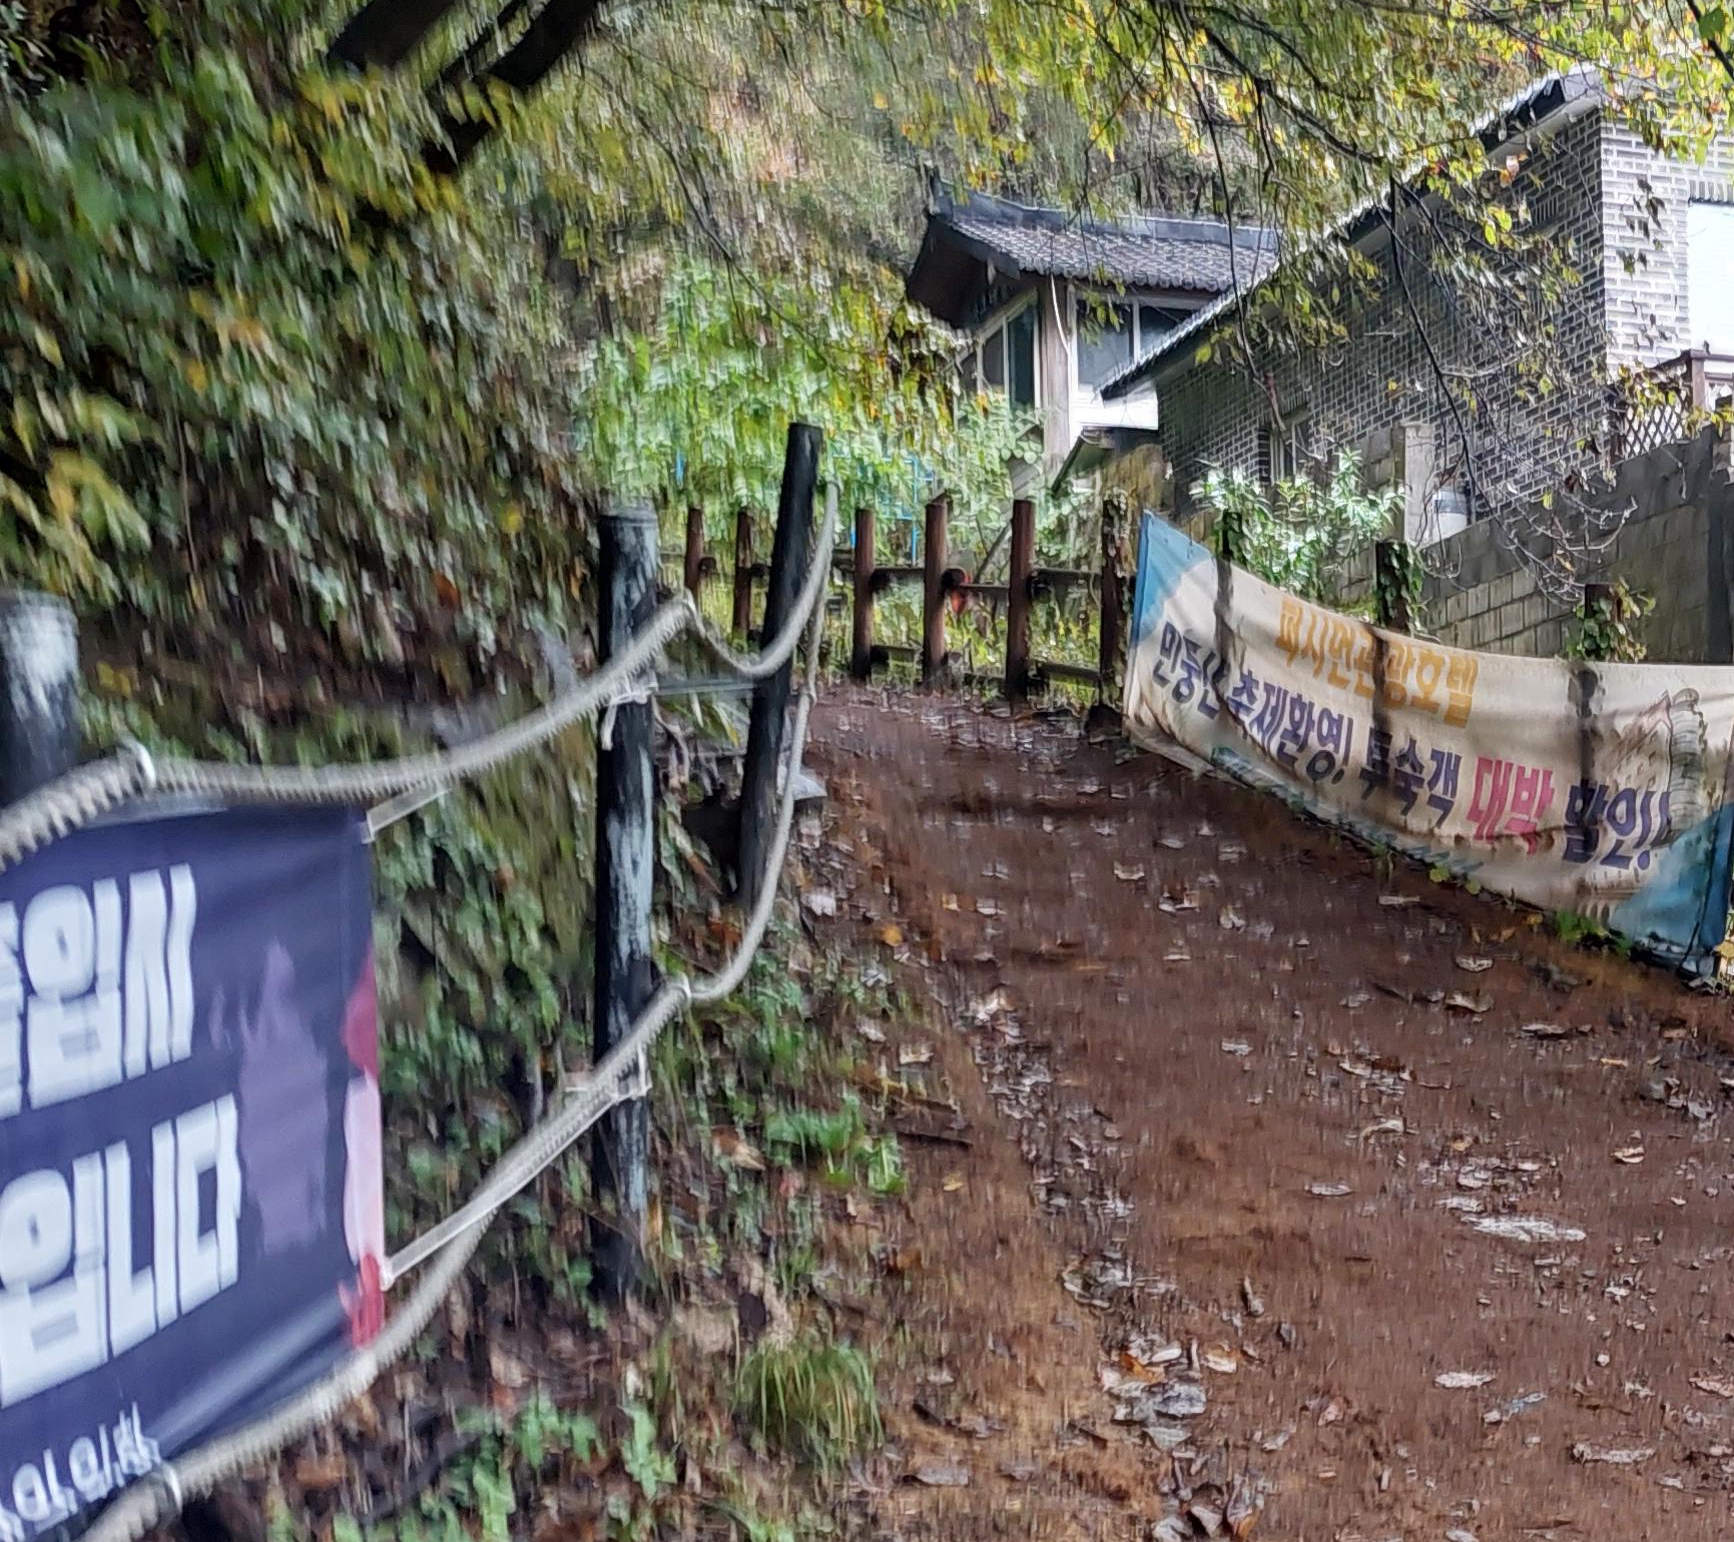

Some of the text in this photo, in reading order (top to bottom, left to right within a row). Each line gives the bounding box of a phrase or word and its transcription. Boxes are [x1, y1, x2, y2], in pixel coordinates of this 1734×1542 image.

[1153, 621, 1228, 719] 민둥산
[1358, 727, 1462, 828] 투숙객
[1466, 755, 1555, 856] 대박
[1562, 781, 1672, 870] 할인!
